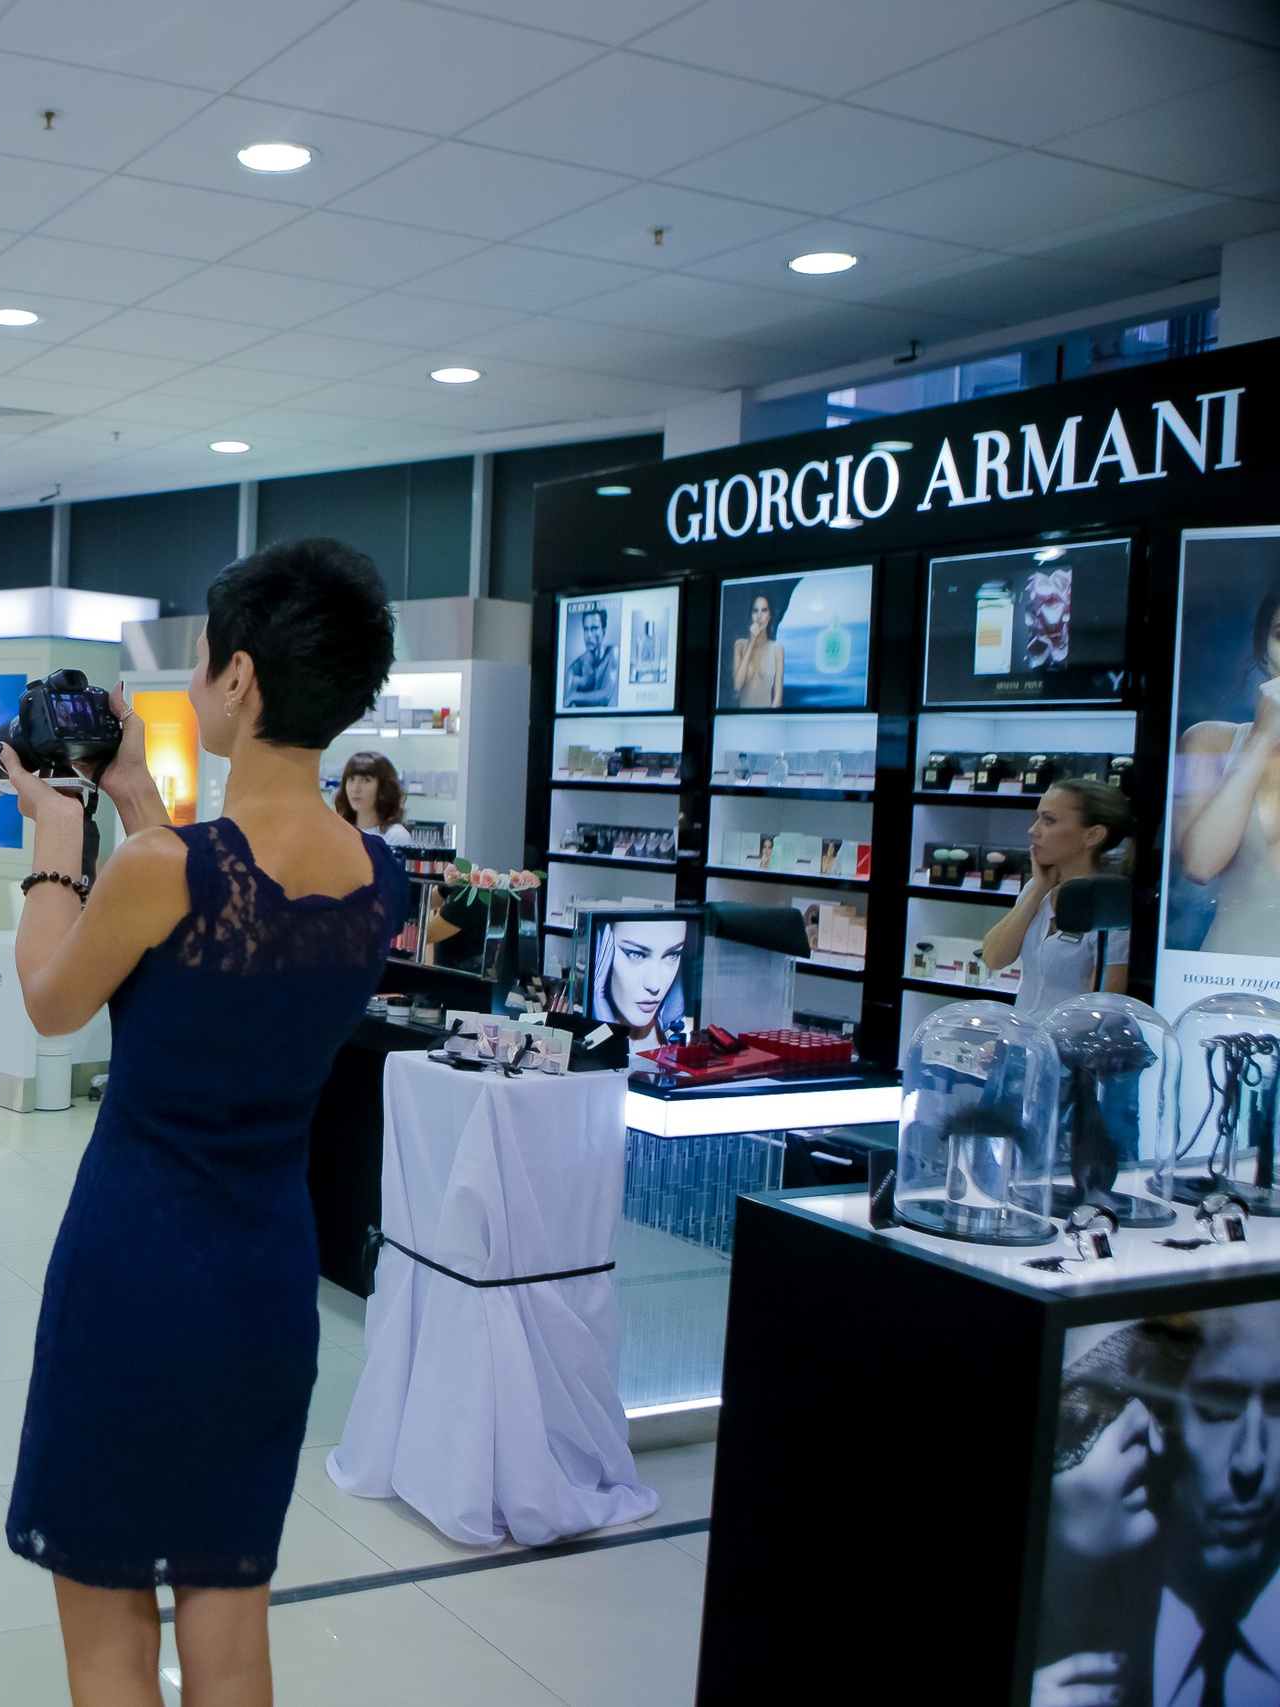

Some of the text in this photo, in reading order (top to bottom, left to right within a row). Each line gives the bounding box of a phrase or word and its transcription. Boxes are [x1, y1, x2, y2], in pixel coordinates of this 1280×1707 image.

[666, 387, 1245, 545] GIORGIO ARMANI
[1183, 974, 1235, 987] новая
